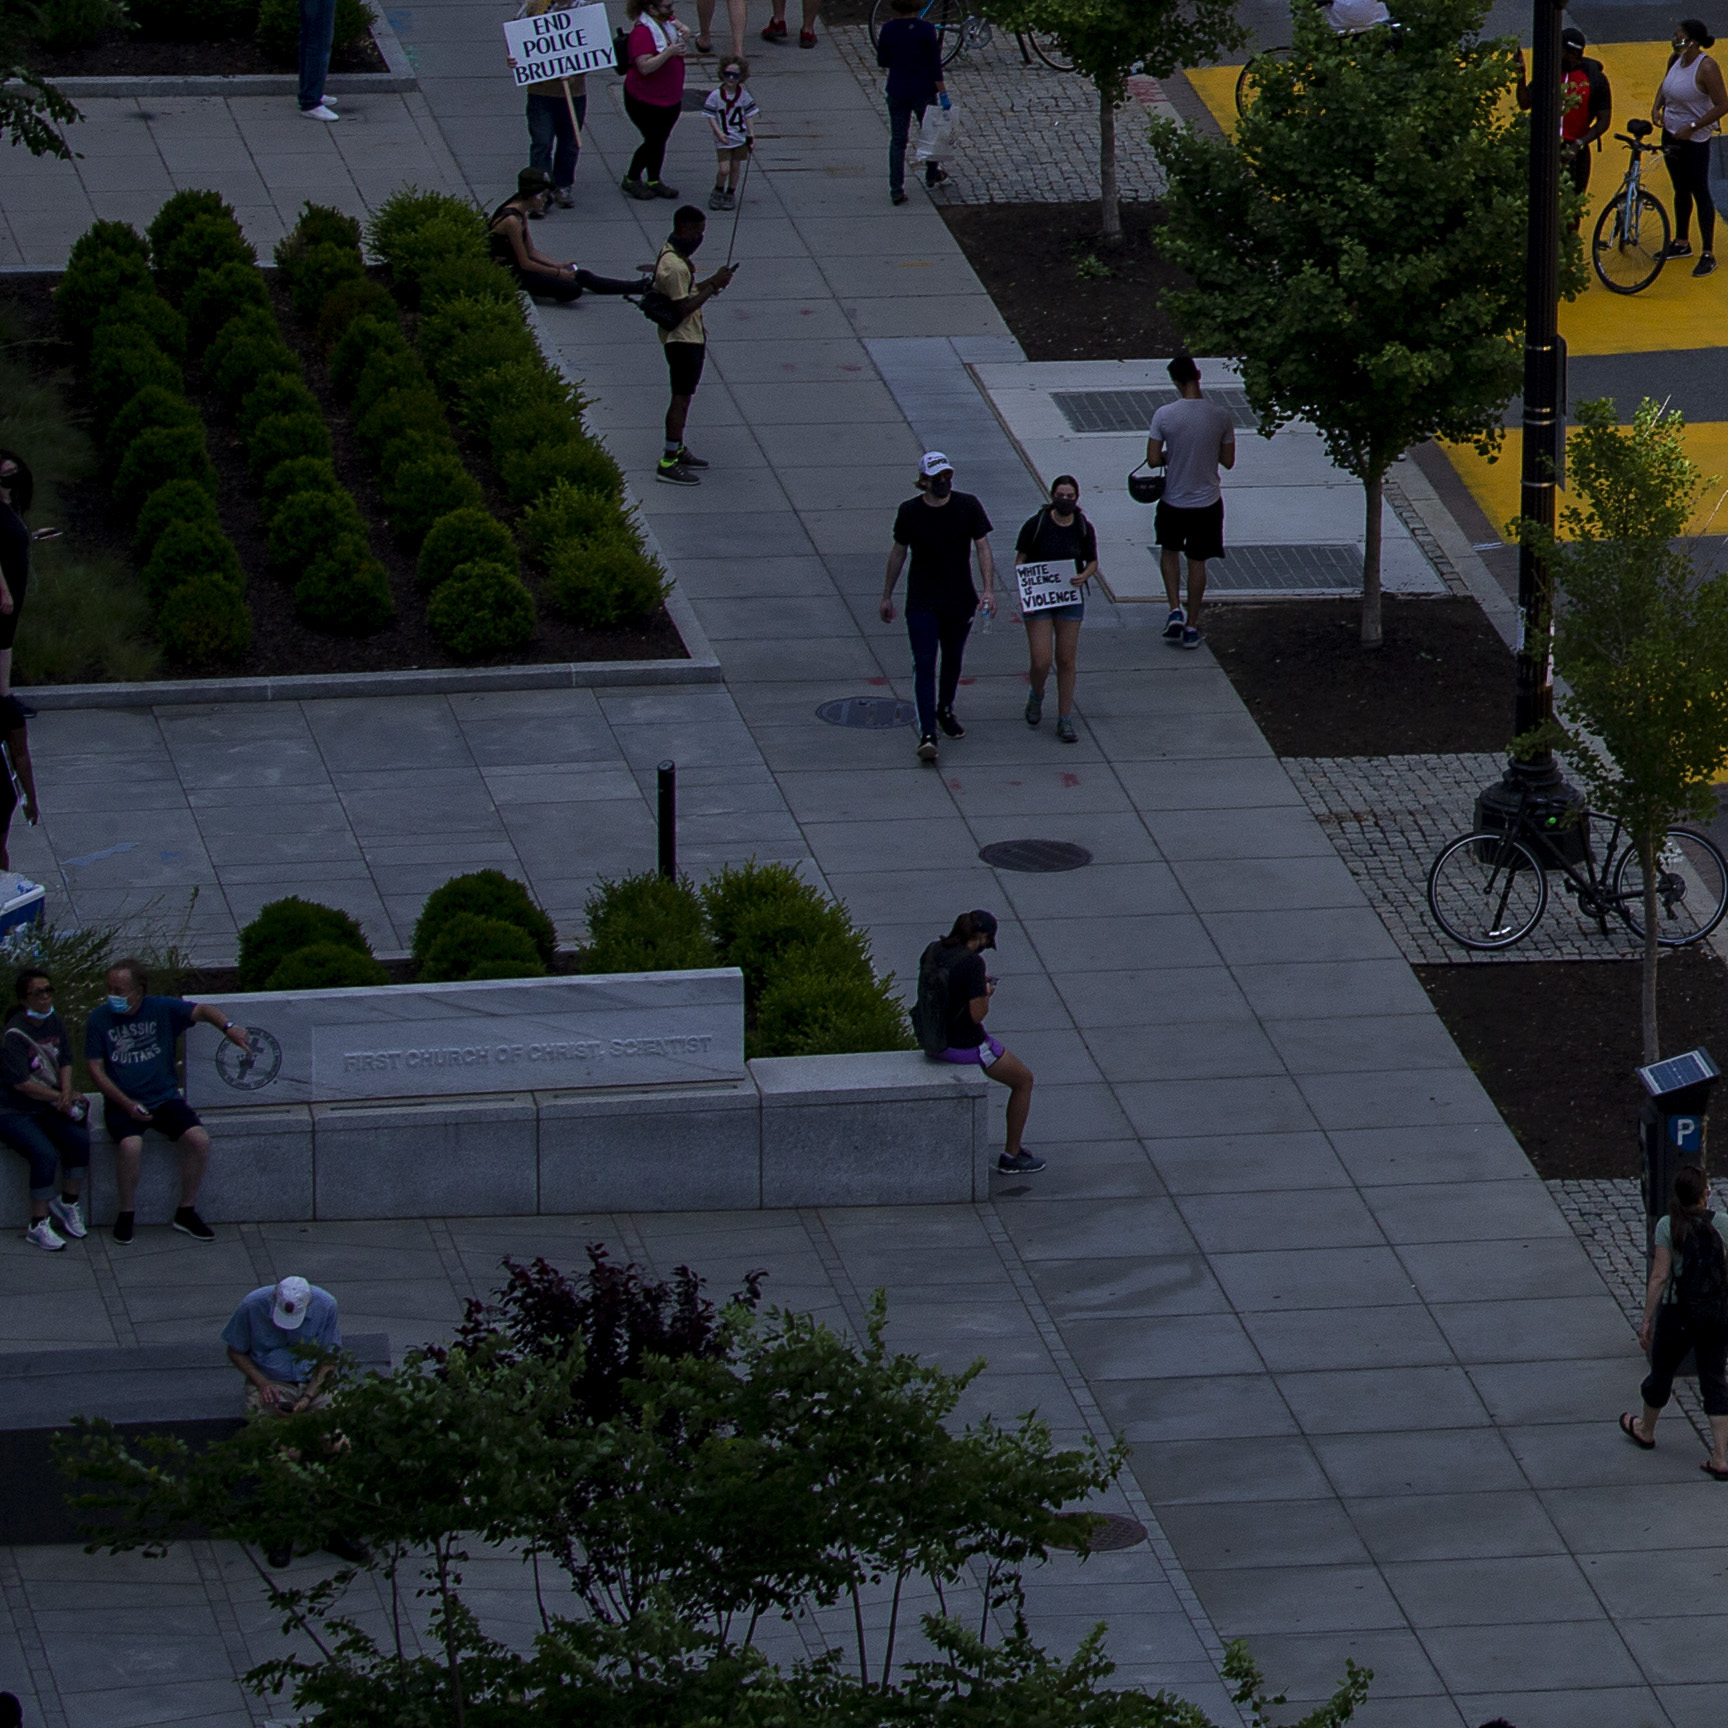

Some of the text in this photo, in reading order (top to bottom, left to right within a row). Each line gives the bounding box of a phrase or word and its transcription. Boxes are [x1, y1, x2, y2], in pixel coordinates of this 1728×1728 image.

[533, 12, 572, 36] END
[522, 28, 588, 58] POLICE
[514, 46, 613, 84] BRUTALITY
[717, 106, 747, 136] 14
[1017, 564, 1049, 578] WHITE
[1021, 573, 1061, 588] SILENCE
[1023, 589, 1079, 608] VIOLENCE
[1024, 585, 1033, 595] IS
[107, 1020, 158, 1043] CLASSIC
[111, 1043, 162, 1065] GUITARS
[344, 1034, 714, 1073] FIRST CHURCH OF CHRIST, SCIENTIST
[1677, 1118, 1695, 1147] P
